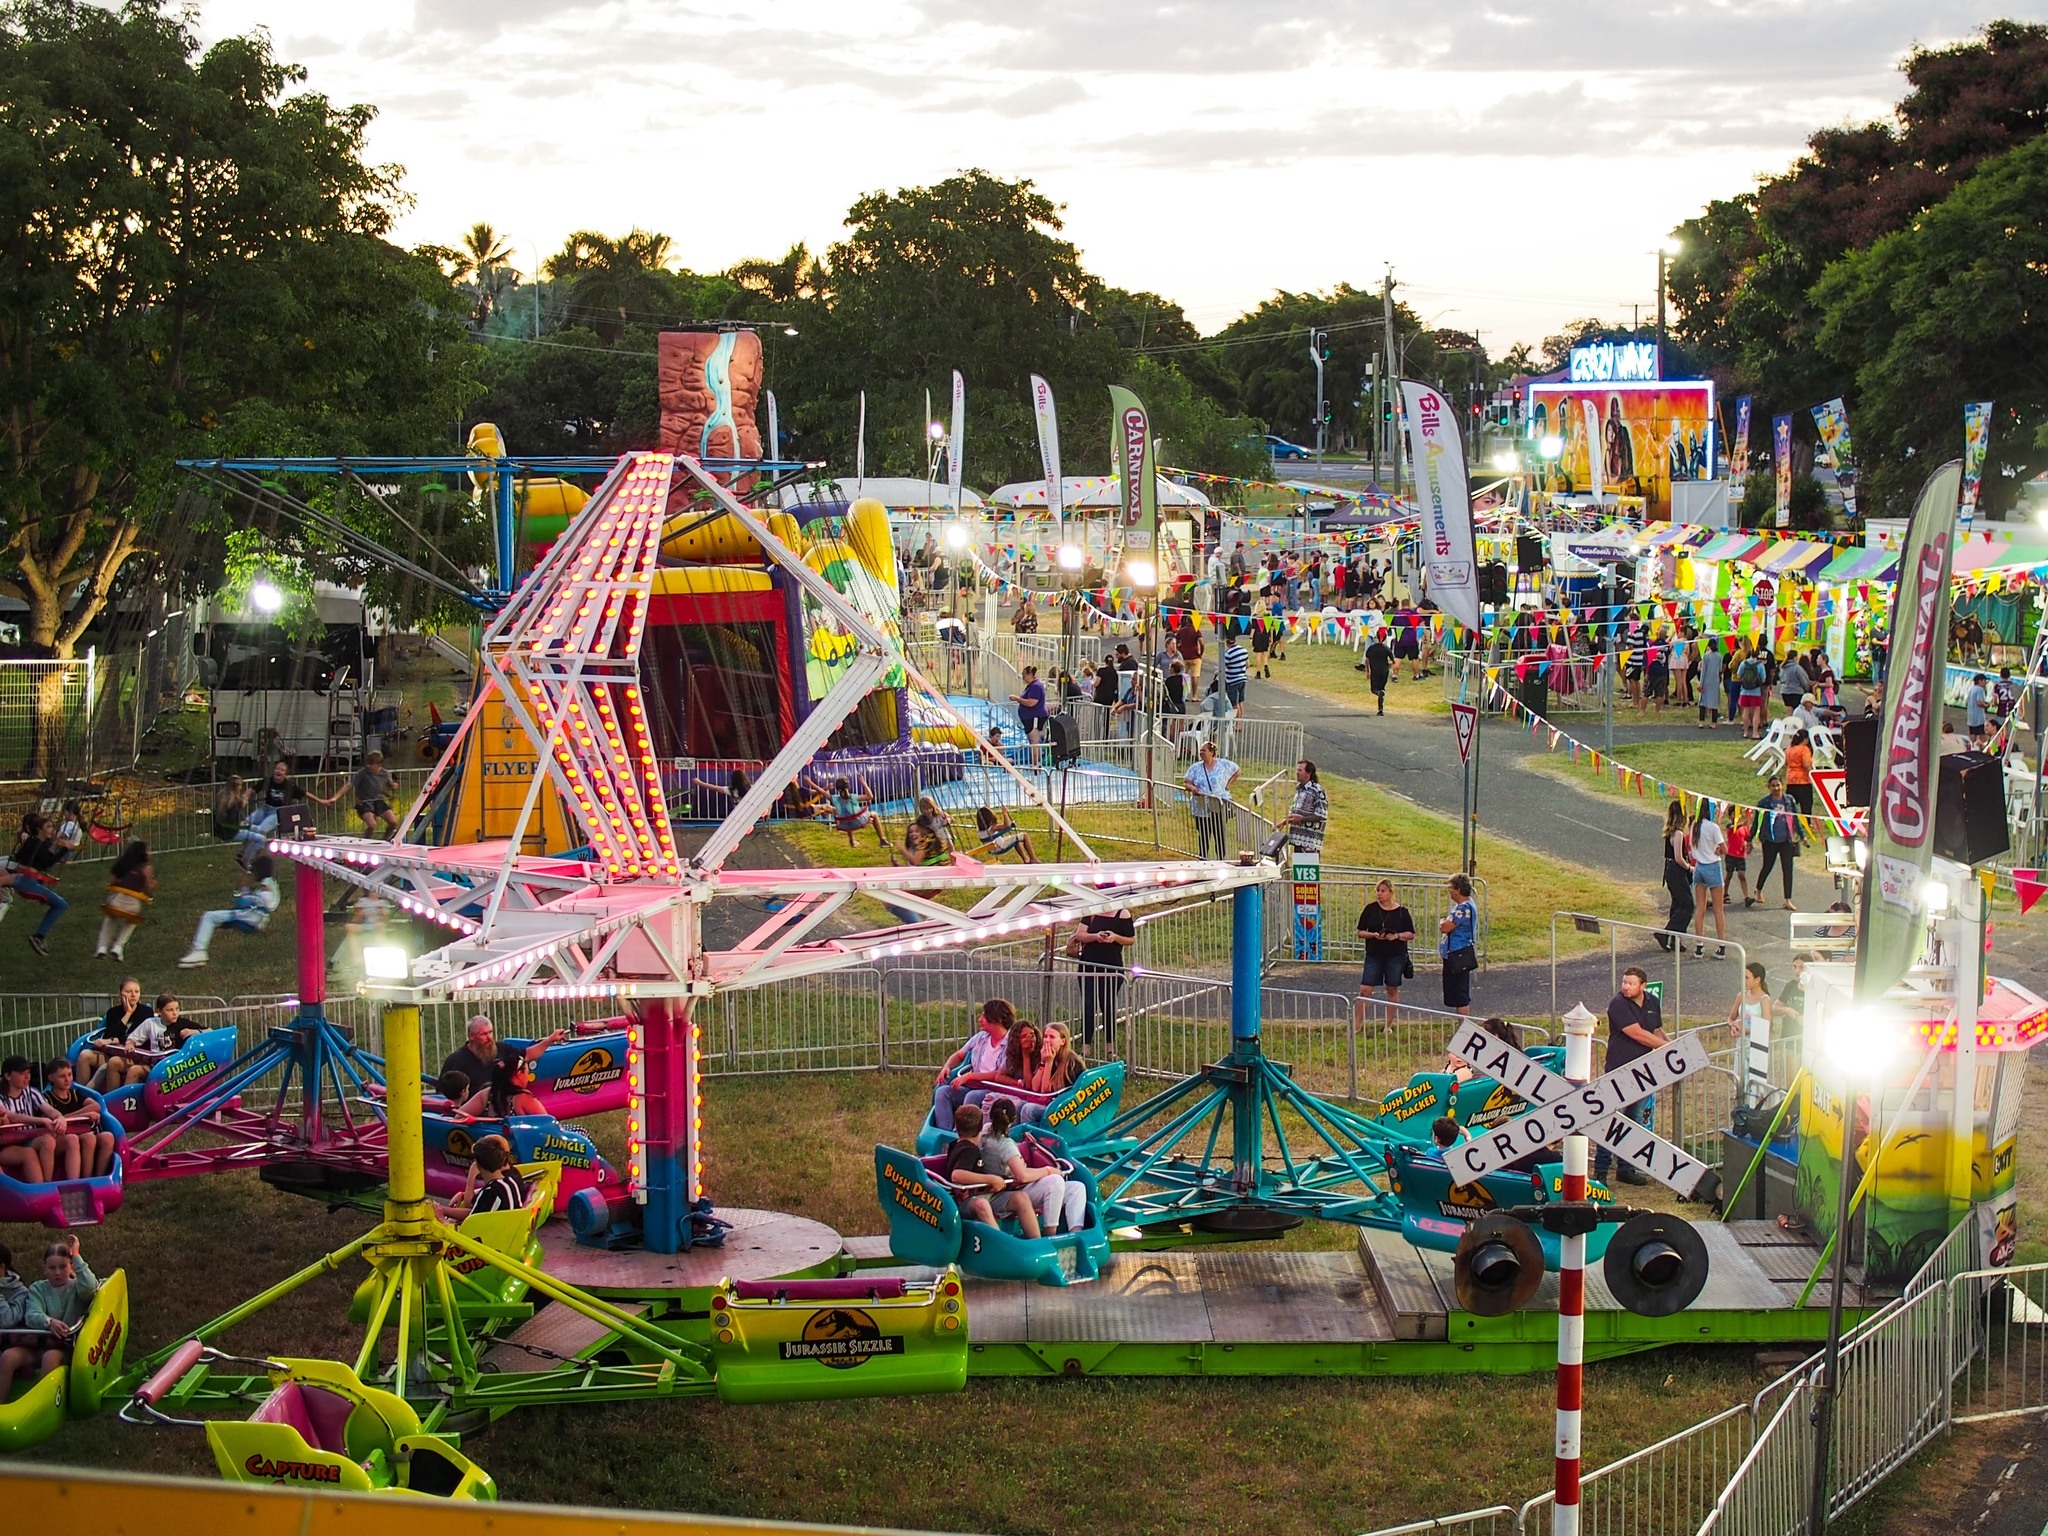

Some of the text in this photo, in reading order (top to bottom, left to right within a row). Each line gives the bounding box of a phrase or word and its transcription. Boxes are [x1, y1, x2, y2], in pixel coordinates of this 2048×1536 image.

[1572, 341, 1654, 382] CRAZY WAVE
[1037, 382, 1047, 410] Bills
[1418, 392, 1441, 437] Bills
[1125, 409, 1146, 522] CARNIVAL
[1349, 505, 1391, 517] ATM
[1423, 439, 1451, 556] Amusements
[1754, 587, 1774, 600] STOP
[1885, 543, 1944, 840] CARNIVAL
[1296, 867, 1317, 881] YES
[1295, 886, 1317, 894] SORRY
[161, 1061, 217, 1094] EXPLORER
[166, 1052, 206, 1079] JUNGLE
[553, 1068, 621, 1092] JURASSIK SIZZLER
[123, 1097, 137, 1112] 12
[1048, 1076, 1108, 1127] BUSH DEVIL
[1069, 1087, 1113, 1126] TRACKER
[1380, 1080, 1433, 1116] BUSH DEVIL
[1394, 1094, 1437, 1122] TRACKER
[1462, 1031, 1691, 1181] RAIL WAY
[1464, 1049, 1687, 1173] CROSSING
[533, 1147, 591, 1169] EXPLORER
[545, 1134, 586, 1154] JUNGLE
[884, 1164, 943, 1212] BUSH DEVIL
[1585, 1183, 1611, 1202] DEVIL
[895, 1189, 939, 1227] TRACKER
[1439, 1200, 1481, 1219] JURASSIK
[973, 1236, 982, 1252] 3
[785, 1339, 893, 1358] JURASSIK SIZZLE
[245, 1454, 341, 1483] CAPTURE
